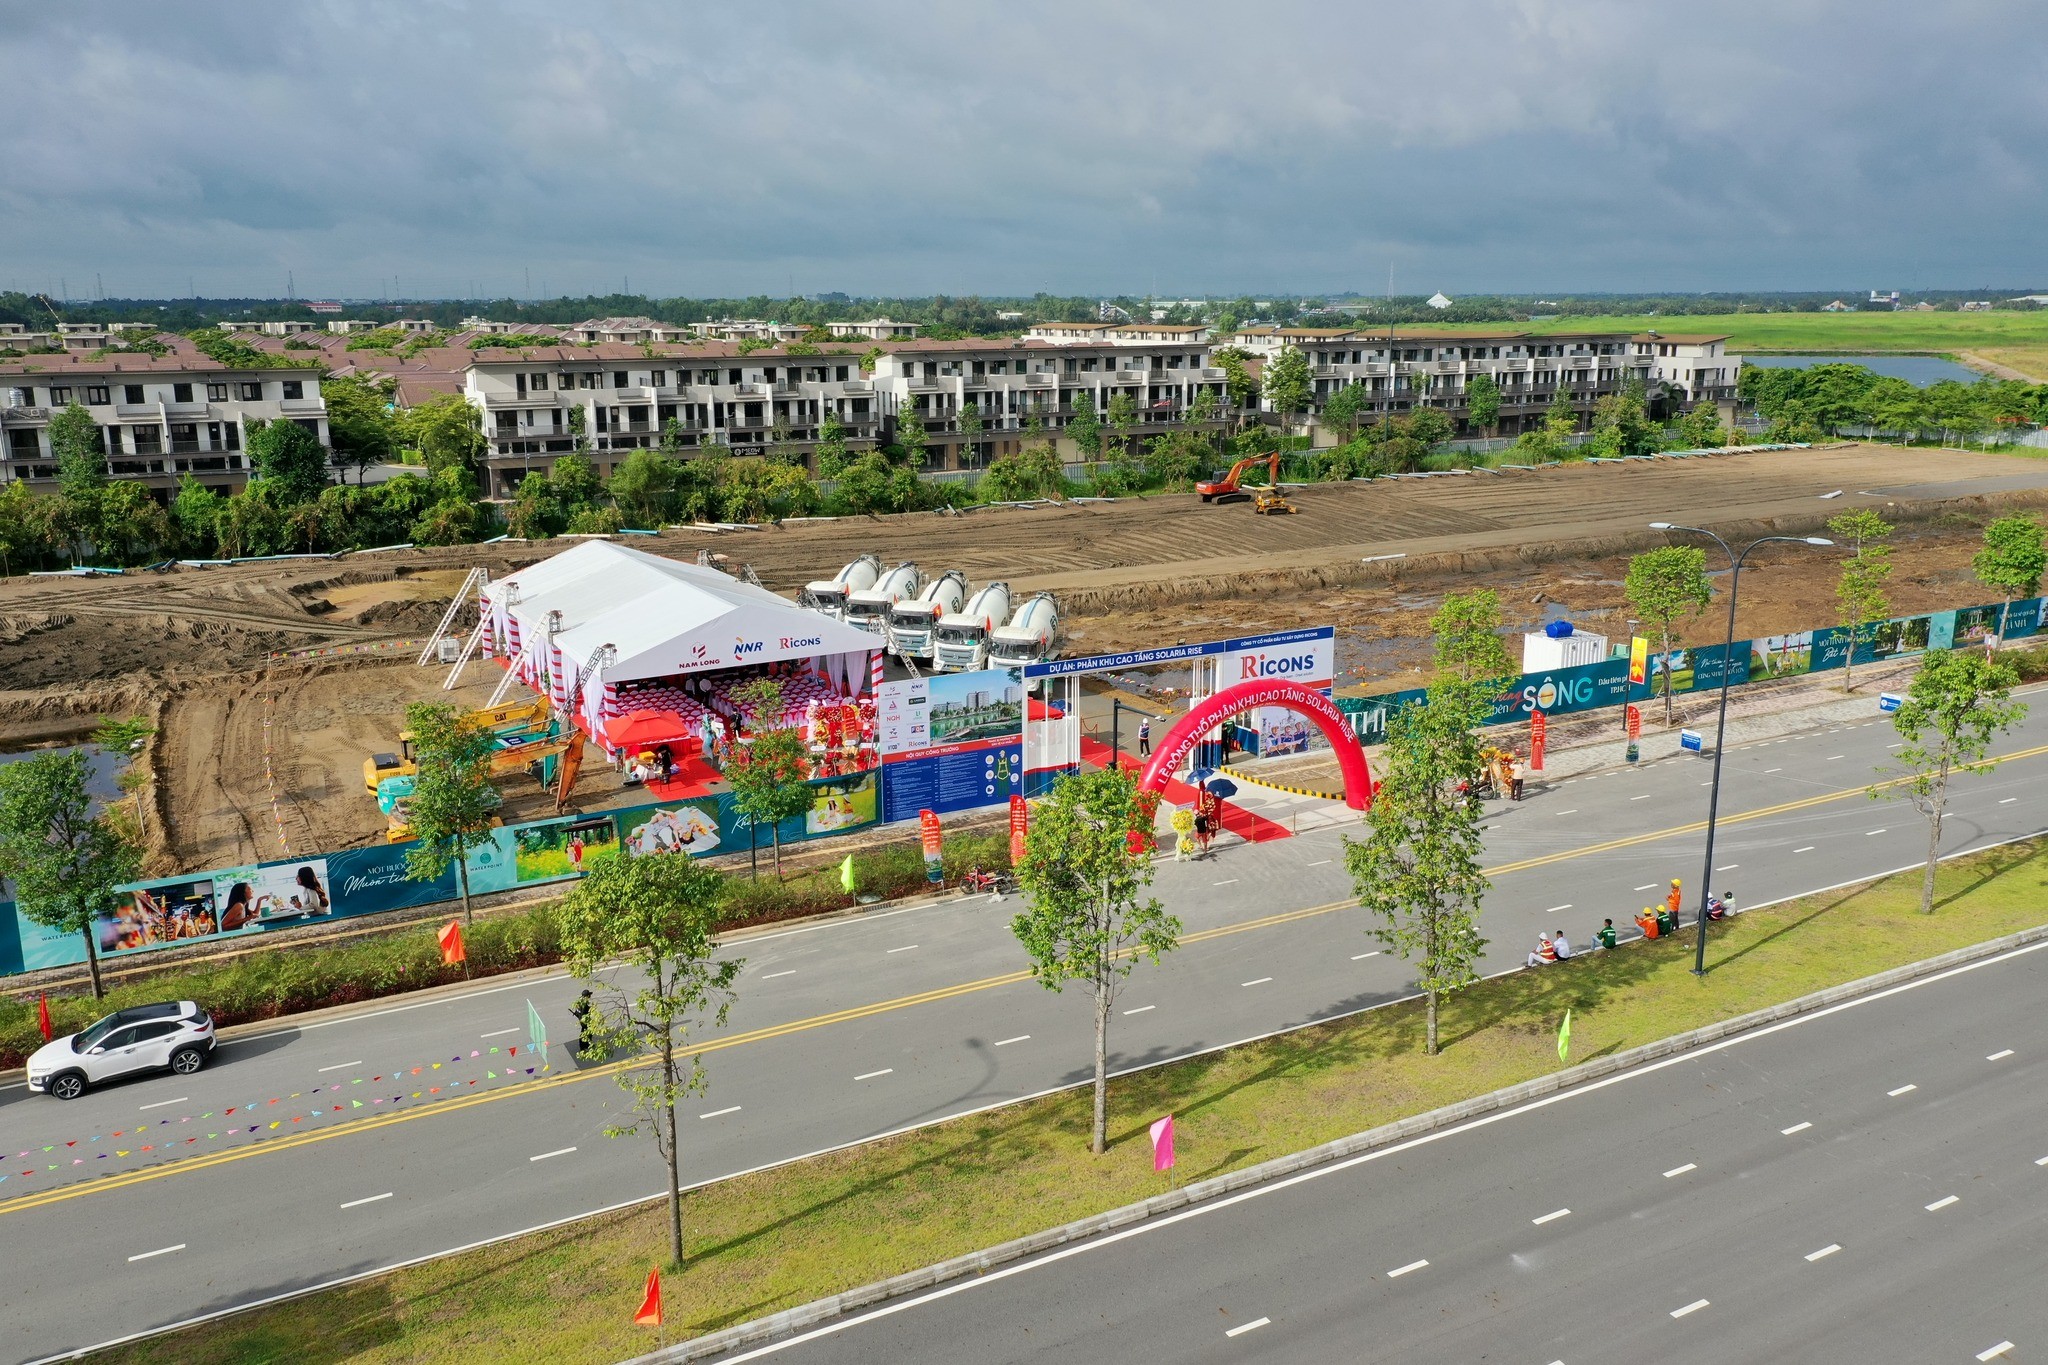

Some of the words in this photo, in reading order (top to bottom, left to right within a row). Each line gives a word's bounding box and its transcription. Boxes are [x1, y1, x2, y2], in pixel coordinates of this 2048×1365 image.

[733, 641, 763, 654] NNR
[700, 658, 720, 666] LONG
[1049, 665, 1061, 674] DỰ
[1062, 661, 1075, 671] ÁN:
[1077, 659, 1097, 670] PHÂN
[1099, 657, 1114, 667] KHU
[1116, 655, 1132, 664] CAO
[1155, 648, 1186, 659] SOLARIA
[1187, 646, 1203, 655] RISE
[1521, 676, 1593, 711] SÔNG
[494, 712, 507, 722] CAT
[1207, 702, 1237, 726] PHÂN
[1237, 693, 1259, 710] KHU
[1259, 689, 1280, 703] CAO
[1305, 695, 1341, 724] SOLARIA
[1338, 716, 1356, 743] RISE
[470, 863, 502, 872] WATERPOINT
